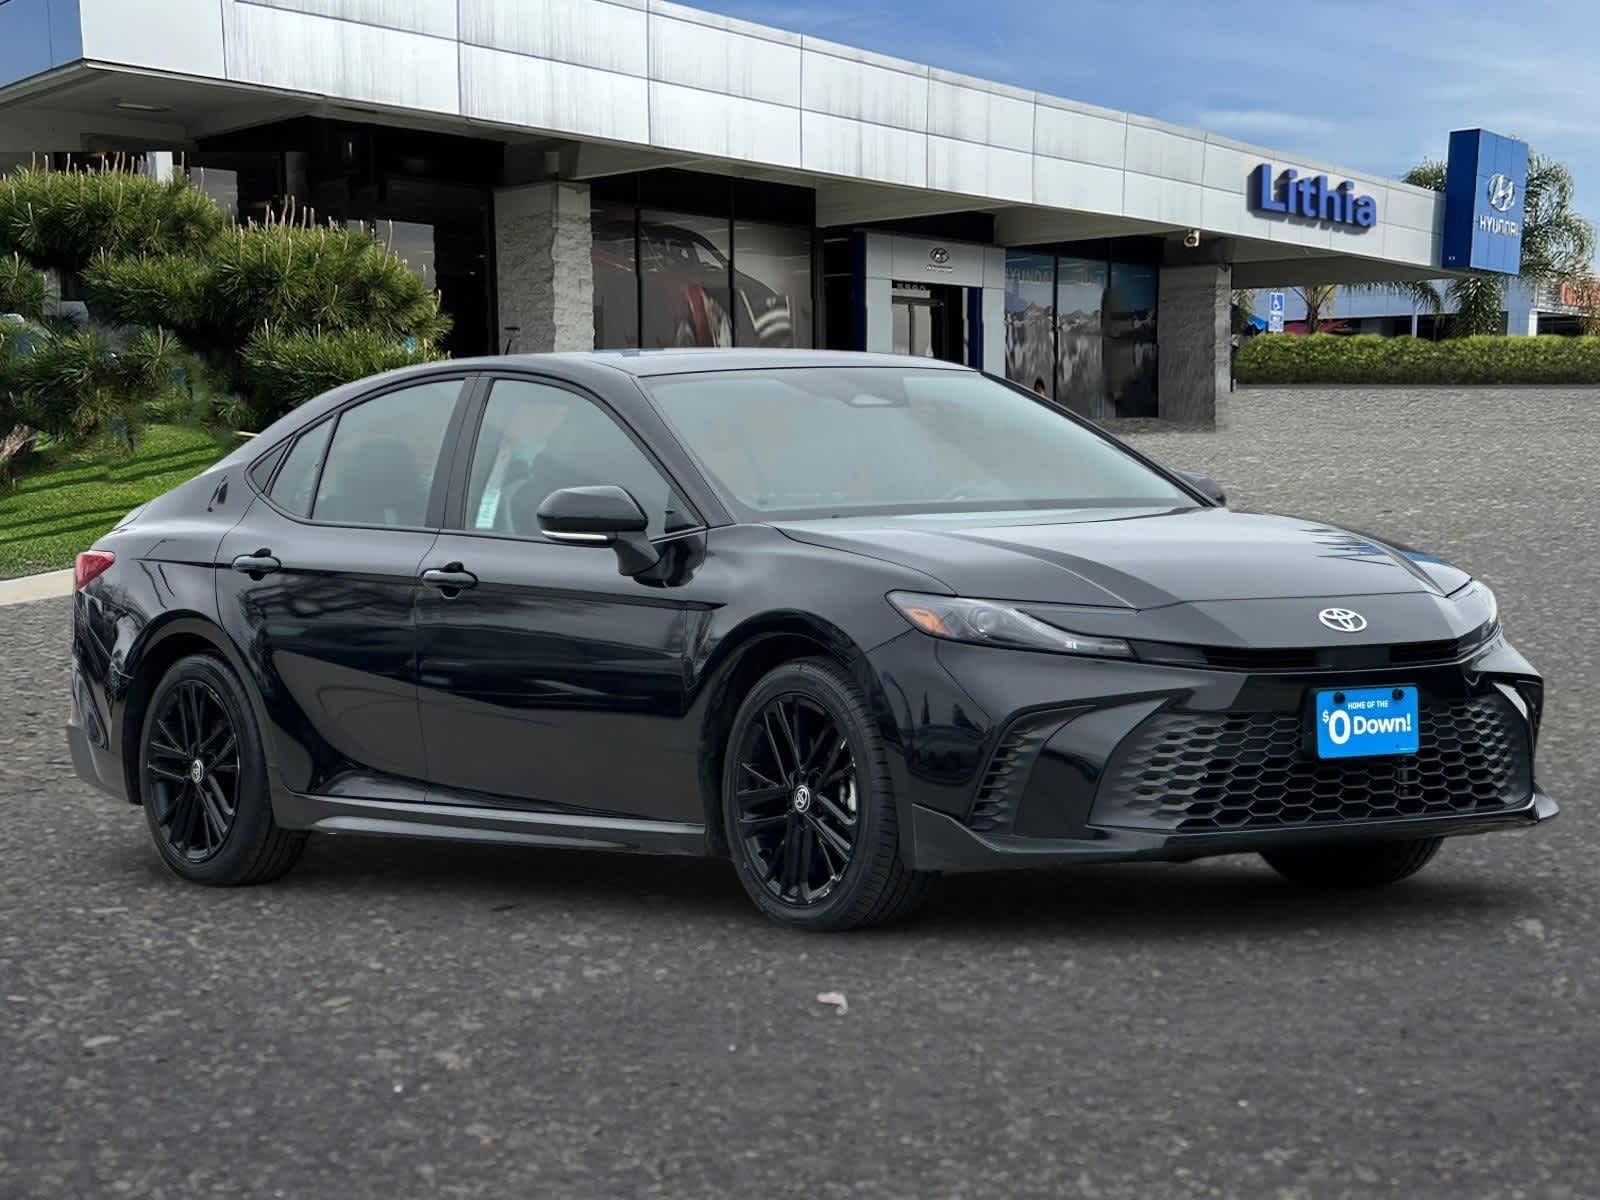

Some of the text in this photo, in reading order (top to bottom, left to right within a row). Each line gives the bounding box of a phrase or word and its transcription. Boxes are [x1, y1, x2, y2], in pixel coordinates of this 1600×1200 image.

[1252, 163, 1377, 230] Lithia
[1480, 215, 1520, 236] HYUNDAI
[1348, 700, 1388, 710] HOME OF THE
[1322, 709, 1411, 745] $0 Down!
